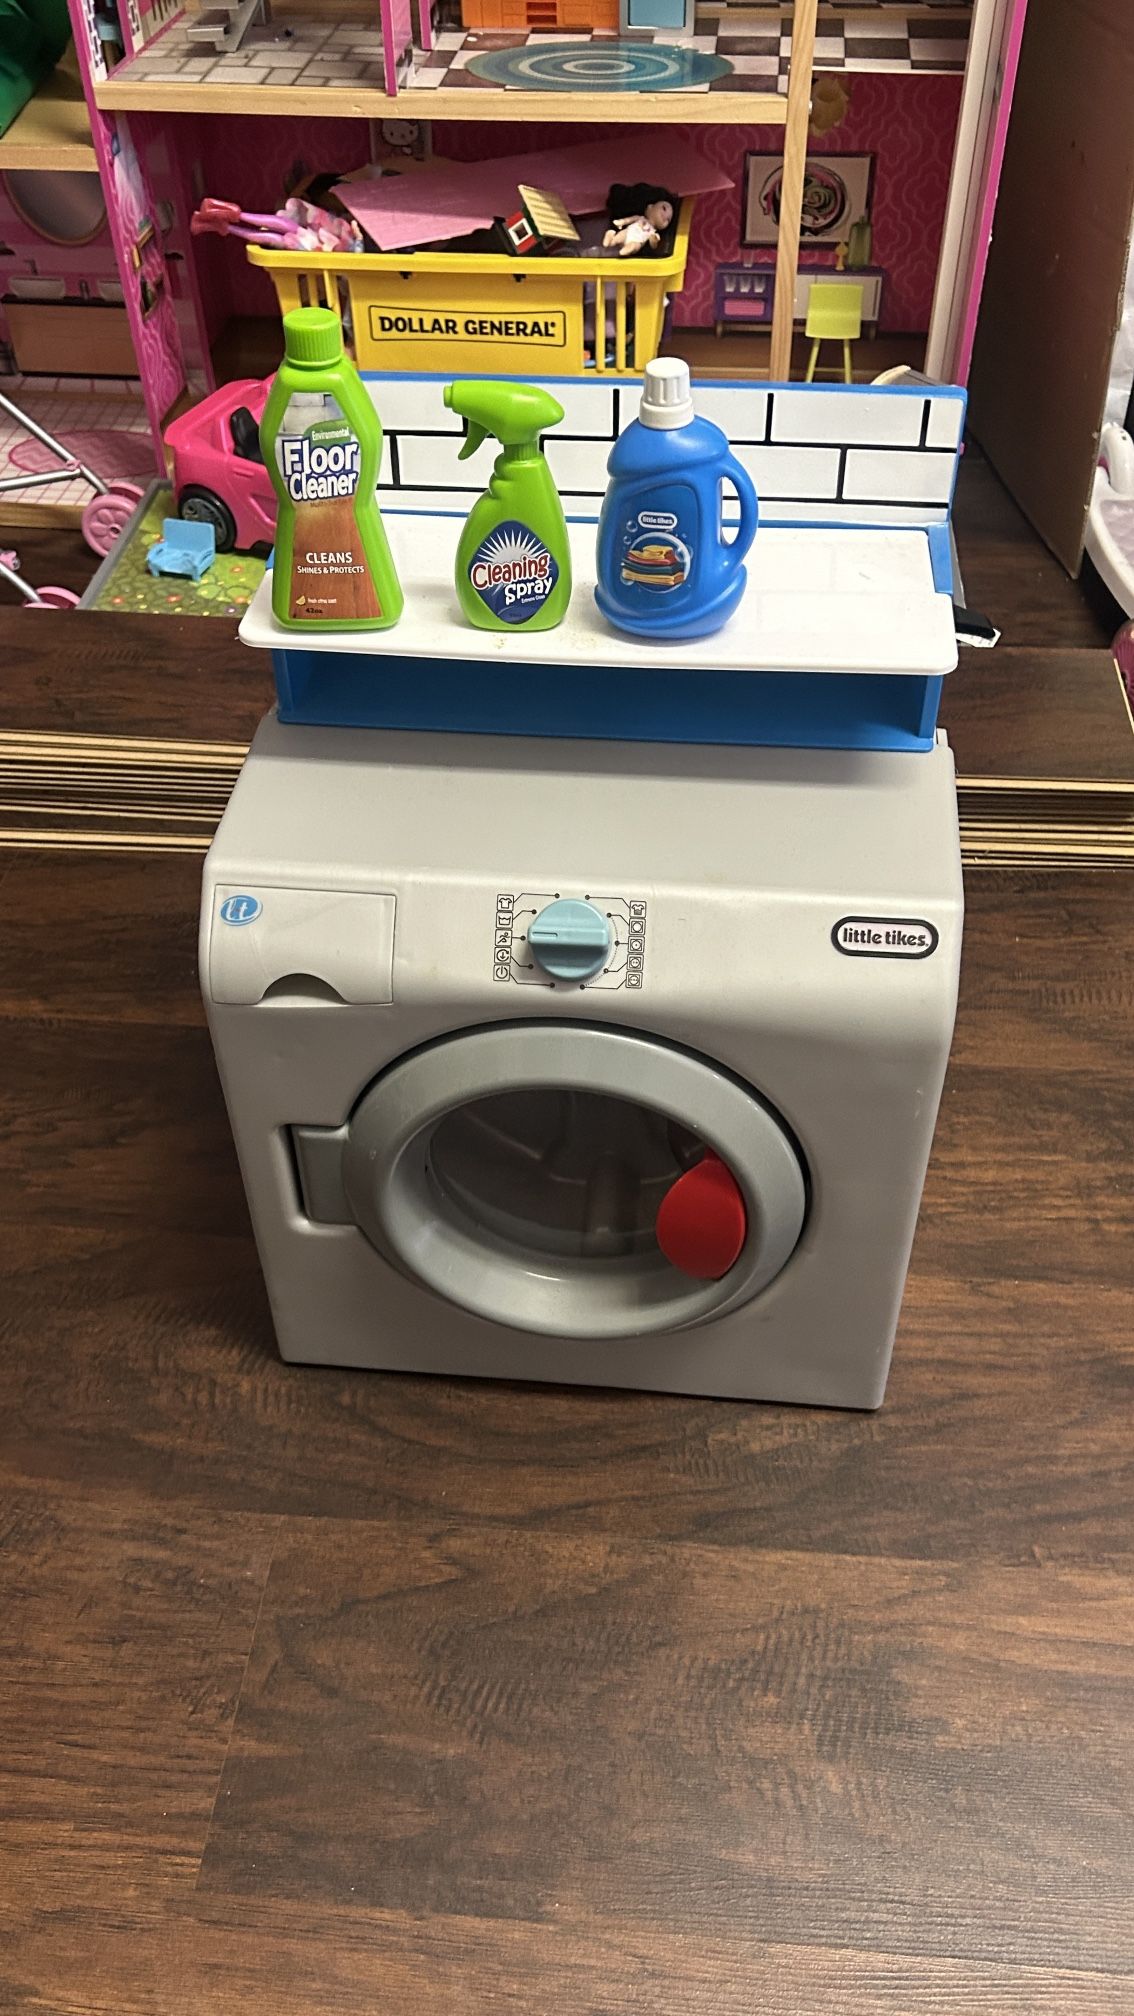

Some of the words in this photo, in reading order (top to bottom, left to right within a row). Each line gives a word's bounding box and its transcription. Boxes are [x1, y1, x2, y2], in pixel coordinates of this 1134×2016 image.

[379, 316, 459, 335] DOLLAR
[464, 319, 555, 337] GENERAL
[283, 439, 358, 476] Floor
[289, 472, 357, 501] Cleaner
[297, 565, 322, 574] SHINES
[322, 566, 329, 574] &
[329, 565, 365, 574] PROTECTS
[305, 552, 353, 564] CLEANS
[471, 553, 550, 590] Cleaning
[504, 577, 552, 605] Spray
[843, 927, 882, 944] little
